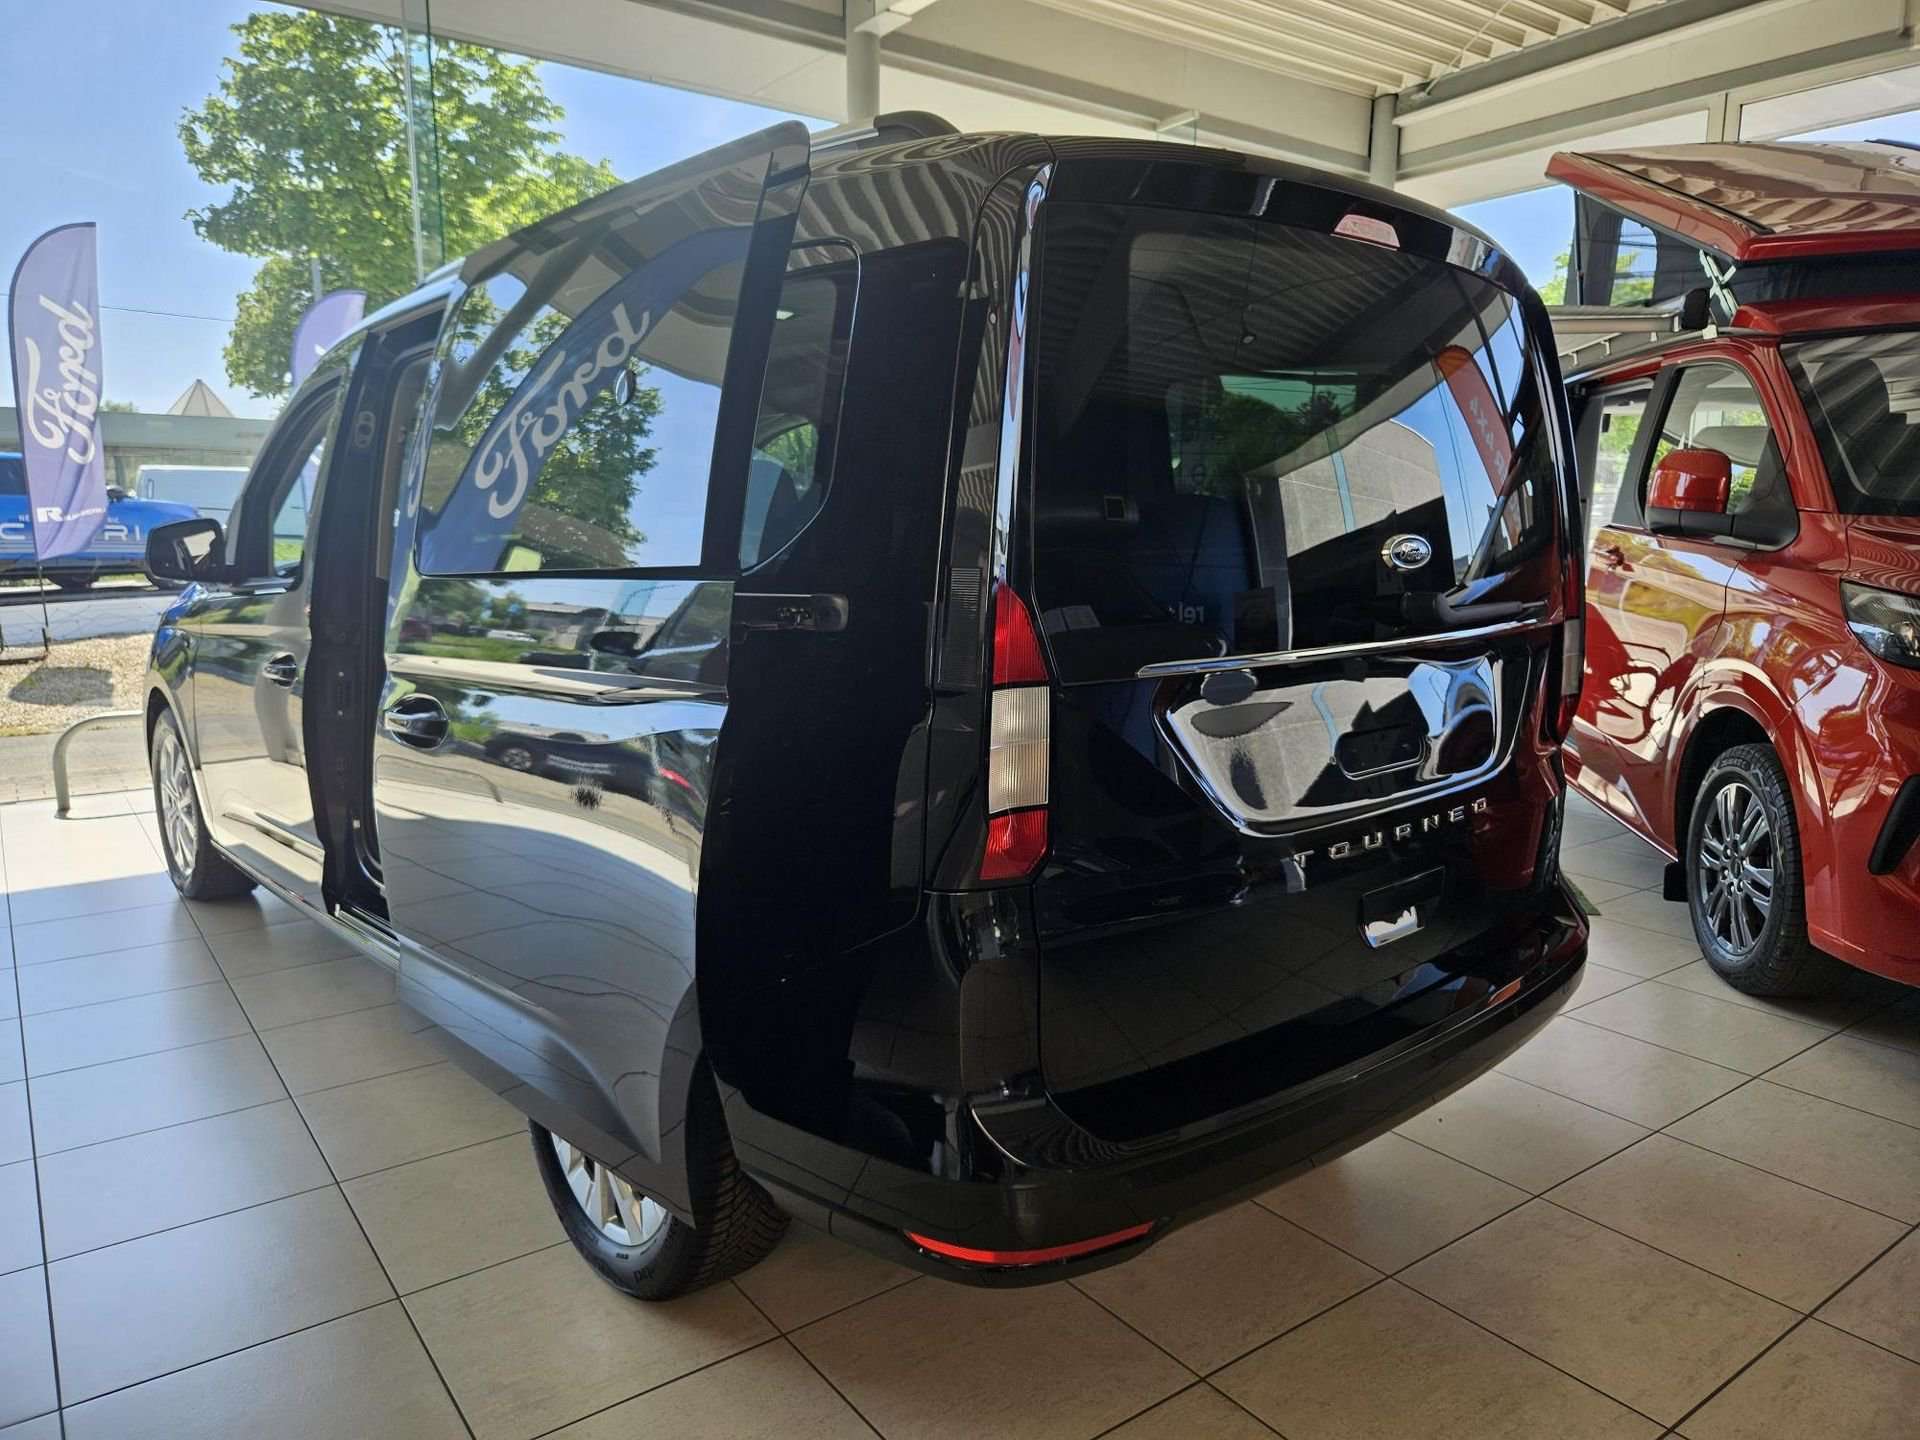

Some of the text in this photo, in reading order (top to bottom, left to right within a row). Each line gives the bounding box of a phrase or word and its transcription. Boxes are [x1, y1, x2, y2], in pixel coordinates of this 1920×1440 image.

[25, 294, 98, 465] Ford
[474, 302, 650, 520] Ford
[1292, 797, 1488, 868] TOURNEO
